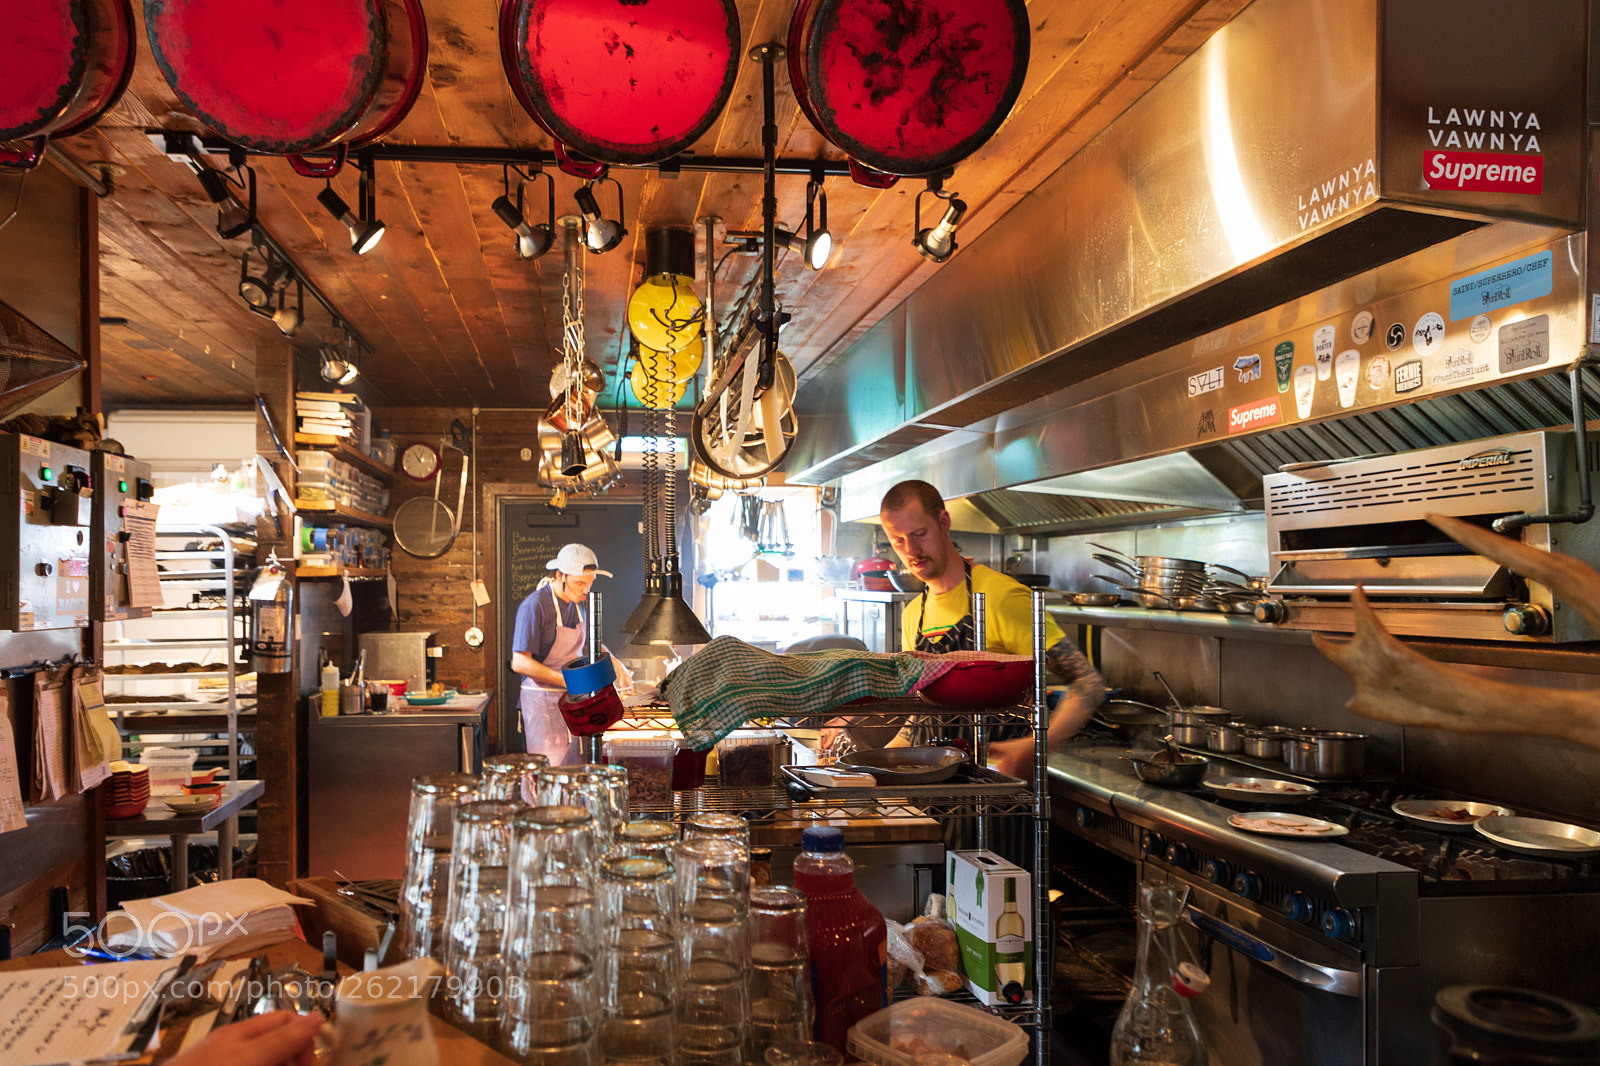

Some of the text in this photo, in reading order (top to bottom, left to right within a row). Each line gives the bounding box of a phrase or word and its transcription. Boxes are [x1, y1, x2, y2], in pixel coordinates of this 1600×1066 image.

[1428, 107, 1541, 130] LAWNYA
[1428, 129, 1541, 153] VAWNYA
[1298, 158, 1377, 212] LAWNYA
[1429, 153, 1537, 188] Supreme
[1297, 181, 1377, 231] VAWNYA
[1452, 258, 1549, 296] SAINT/SUPERHERO/CHEF
[1230, 403, 1277, 428] Supreme
[1459, 454, 1511, 469] IMPERIAL
